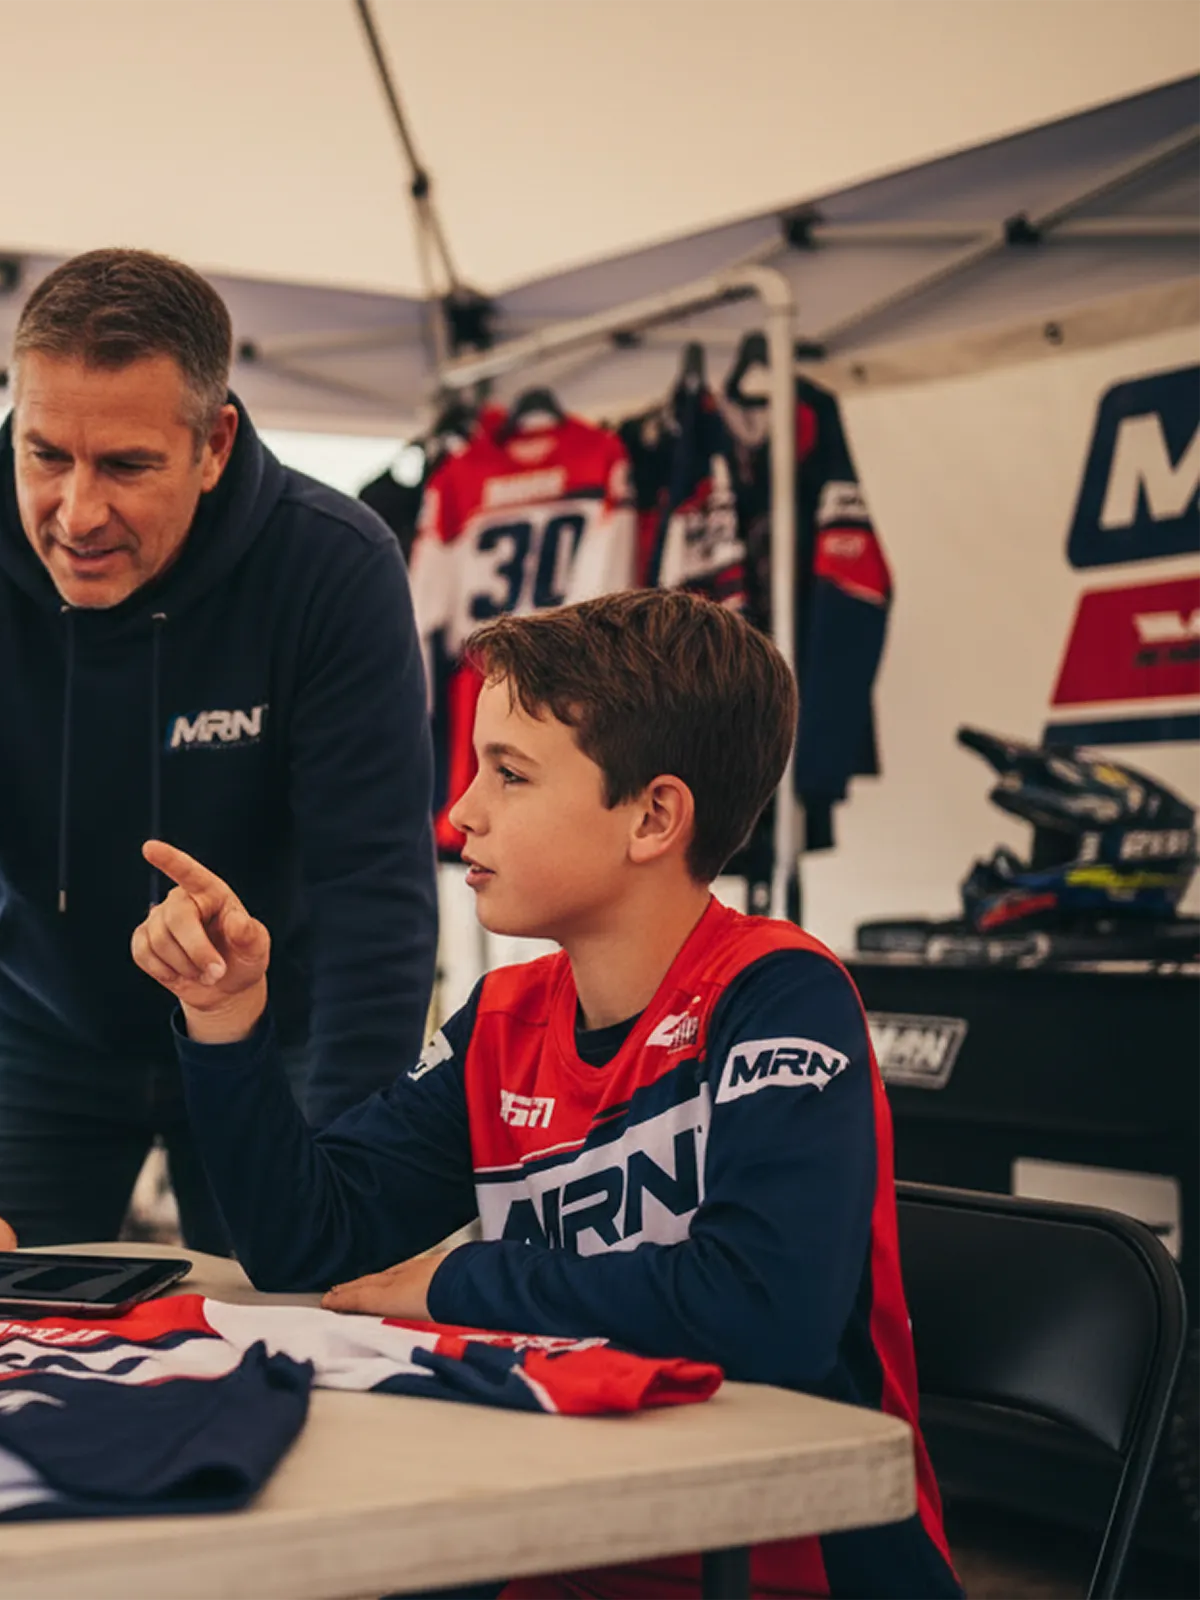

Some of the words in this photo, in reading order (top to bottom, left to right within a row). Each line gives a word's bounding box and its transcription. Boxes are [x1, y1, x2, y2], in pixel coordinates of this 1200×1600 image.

[470, 513, 585, 620] 30
[169, 704, 263, 748] MRN
[728, 1046, 841, 1088] MRN
[501, 1127, 701, 1252] MRN
